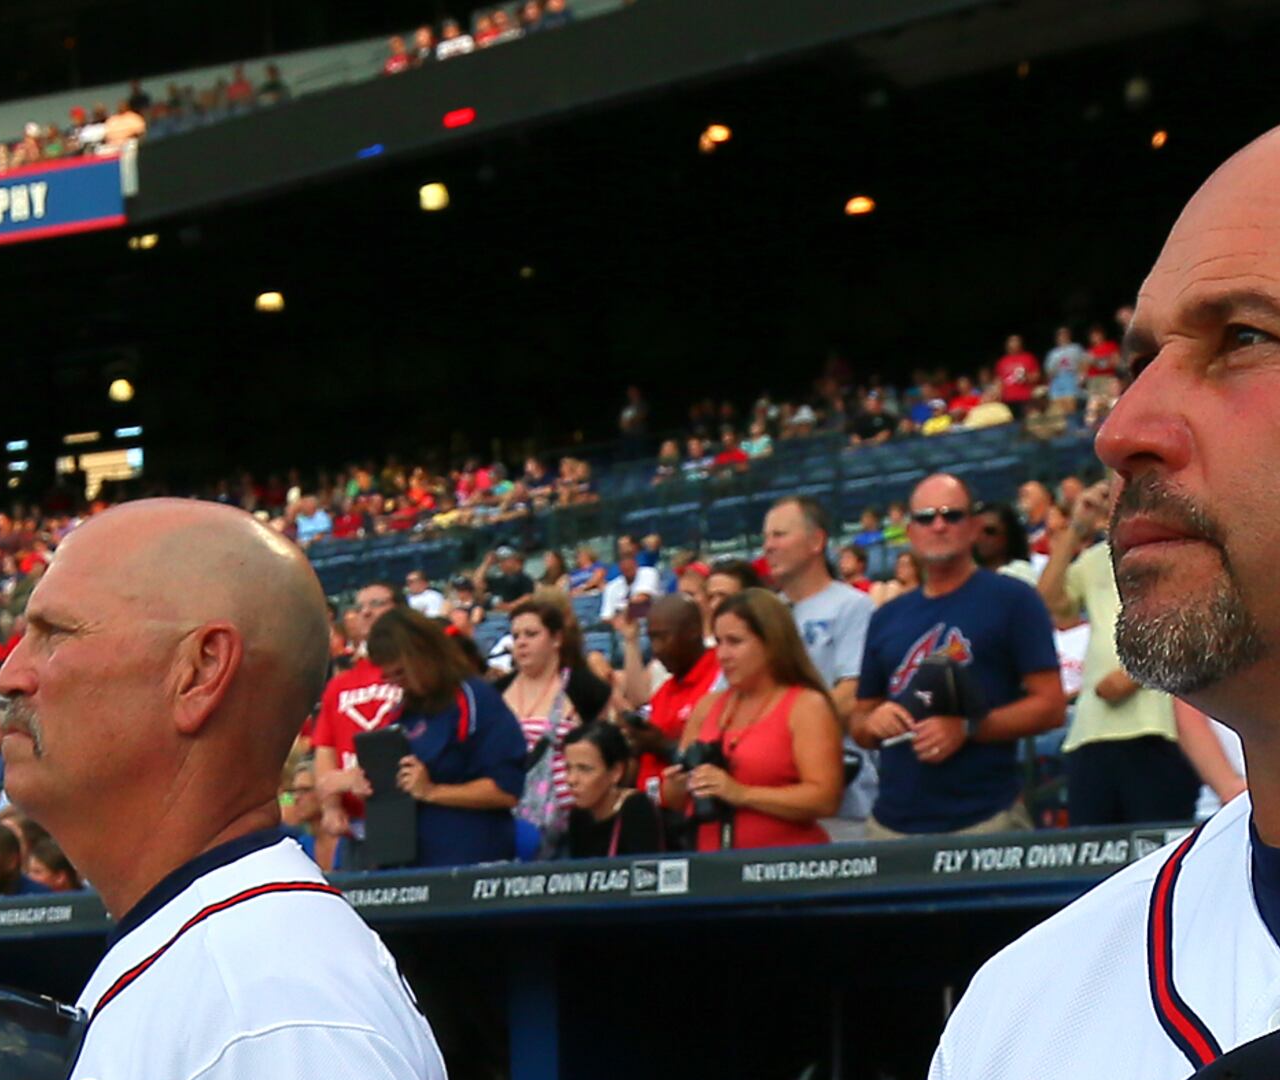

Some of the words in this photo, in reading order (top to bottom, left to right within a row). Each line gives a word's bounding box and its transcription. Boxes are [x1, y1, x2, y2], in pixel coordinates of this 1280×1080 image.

[741, 855, 878, 883] NEWERACAP.COM
[932, 849, 969, 874] FLY
[971, 845, 1024, 873] YOUR
[1026, 842, 1077, 869] OWN
[1078, 838, 1129, 867] FLAG
[472, 877, 502, 900] FLY
[503, 873, 547, 898] YOUR
[547, 871, 588, 896] OWN
[588, 868, 630, 893] FLAG
